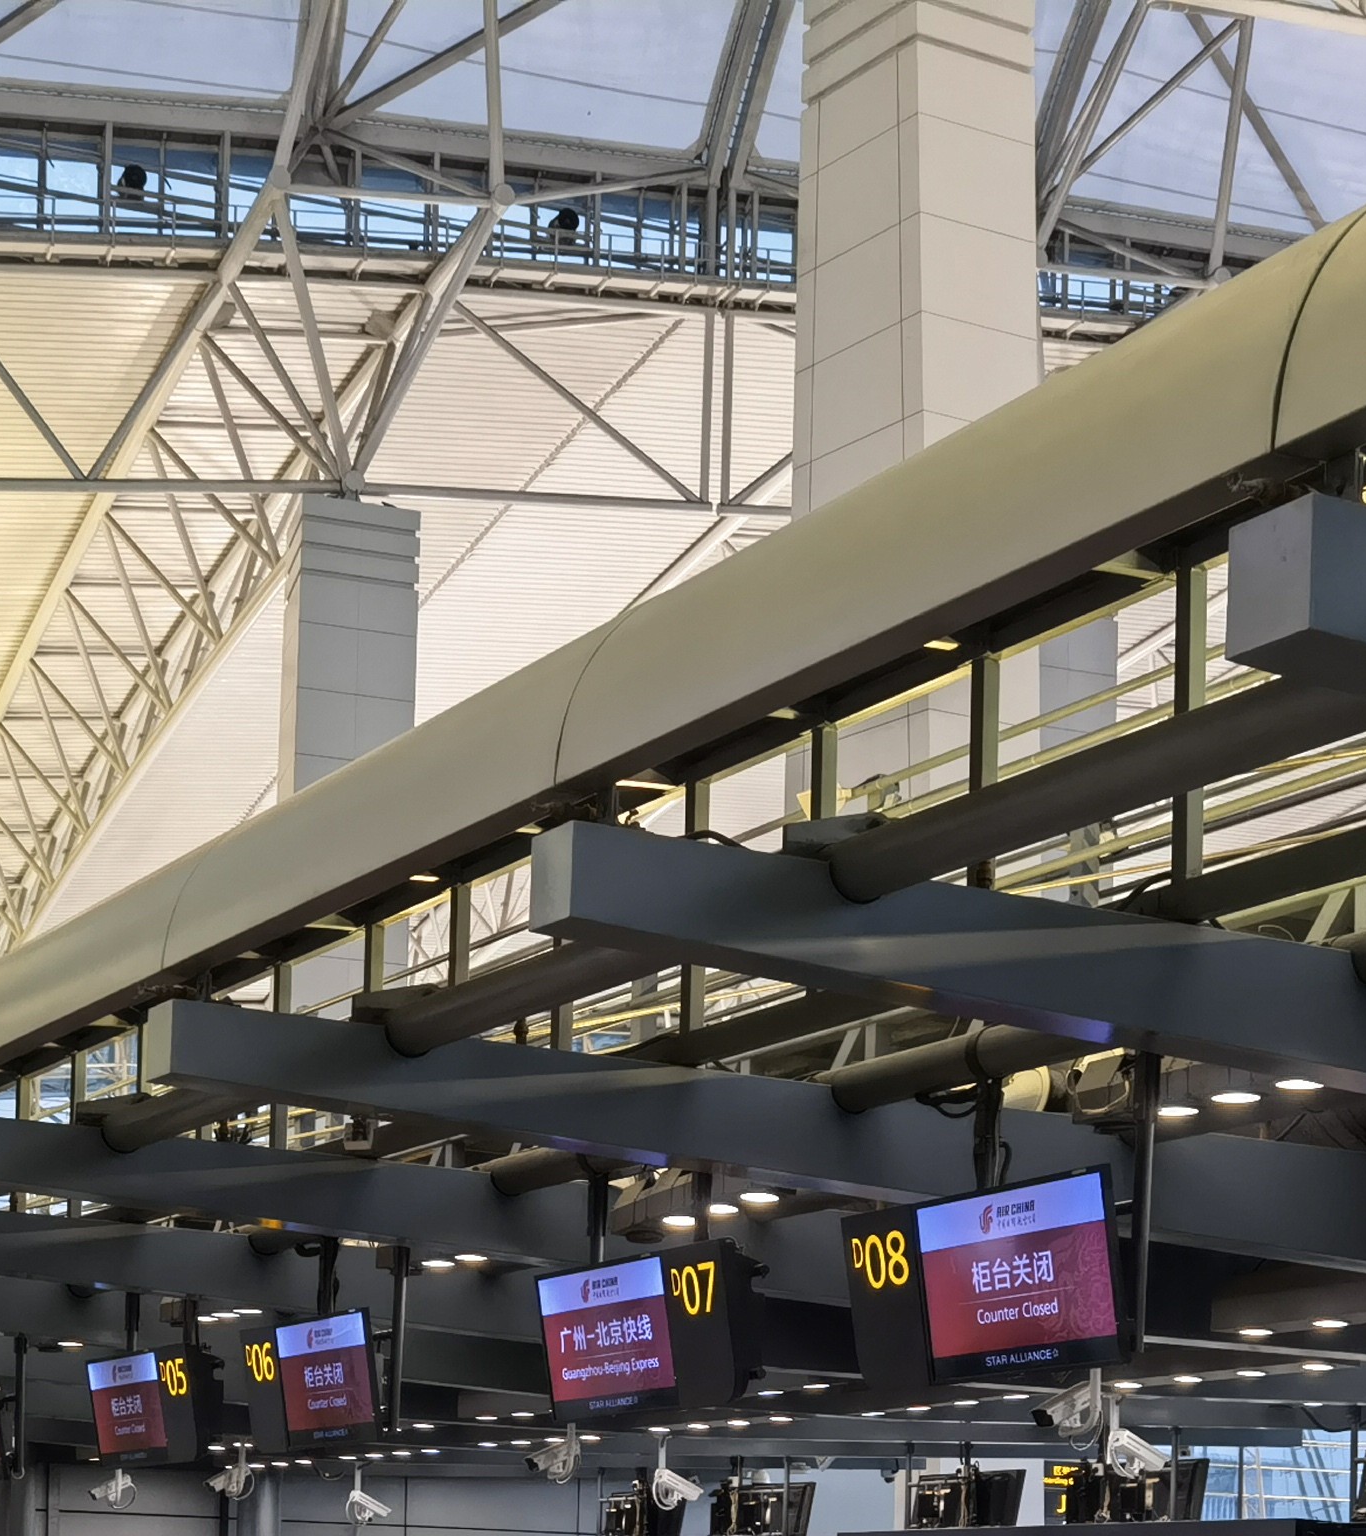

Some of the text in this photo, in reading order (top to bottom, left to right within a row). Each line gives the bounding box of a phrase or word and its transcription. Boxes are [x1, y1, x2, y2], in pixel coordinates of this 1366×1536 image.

[996, 1200, 1036, 1218] AIR CHINA
[851, 1229, 910, 1290] D08
[971, 1250, 1054, 1294] 柜台关闭
[670, 1261, 715, 1316] D07
[976, 1297, 1059, 1325] Counter Closed
[631, 1357, 660, 1372] Express
[985, 1349, 1053, 1367] STAR ALLIANCE
[304, 1362, 344, 1388] 柜台关闭
[111, 1394, 143, 1417] 柜台关闭
